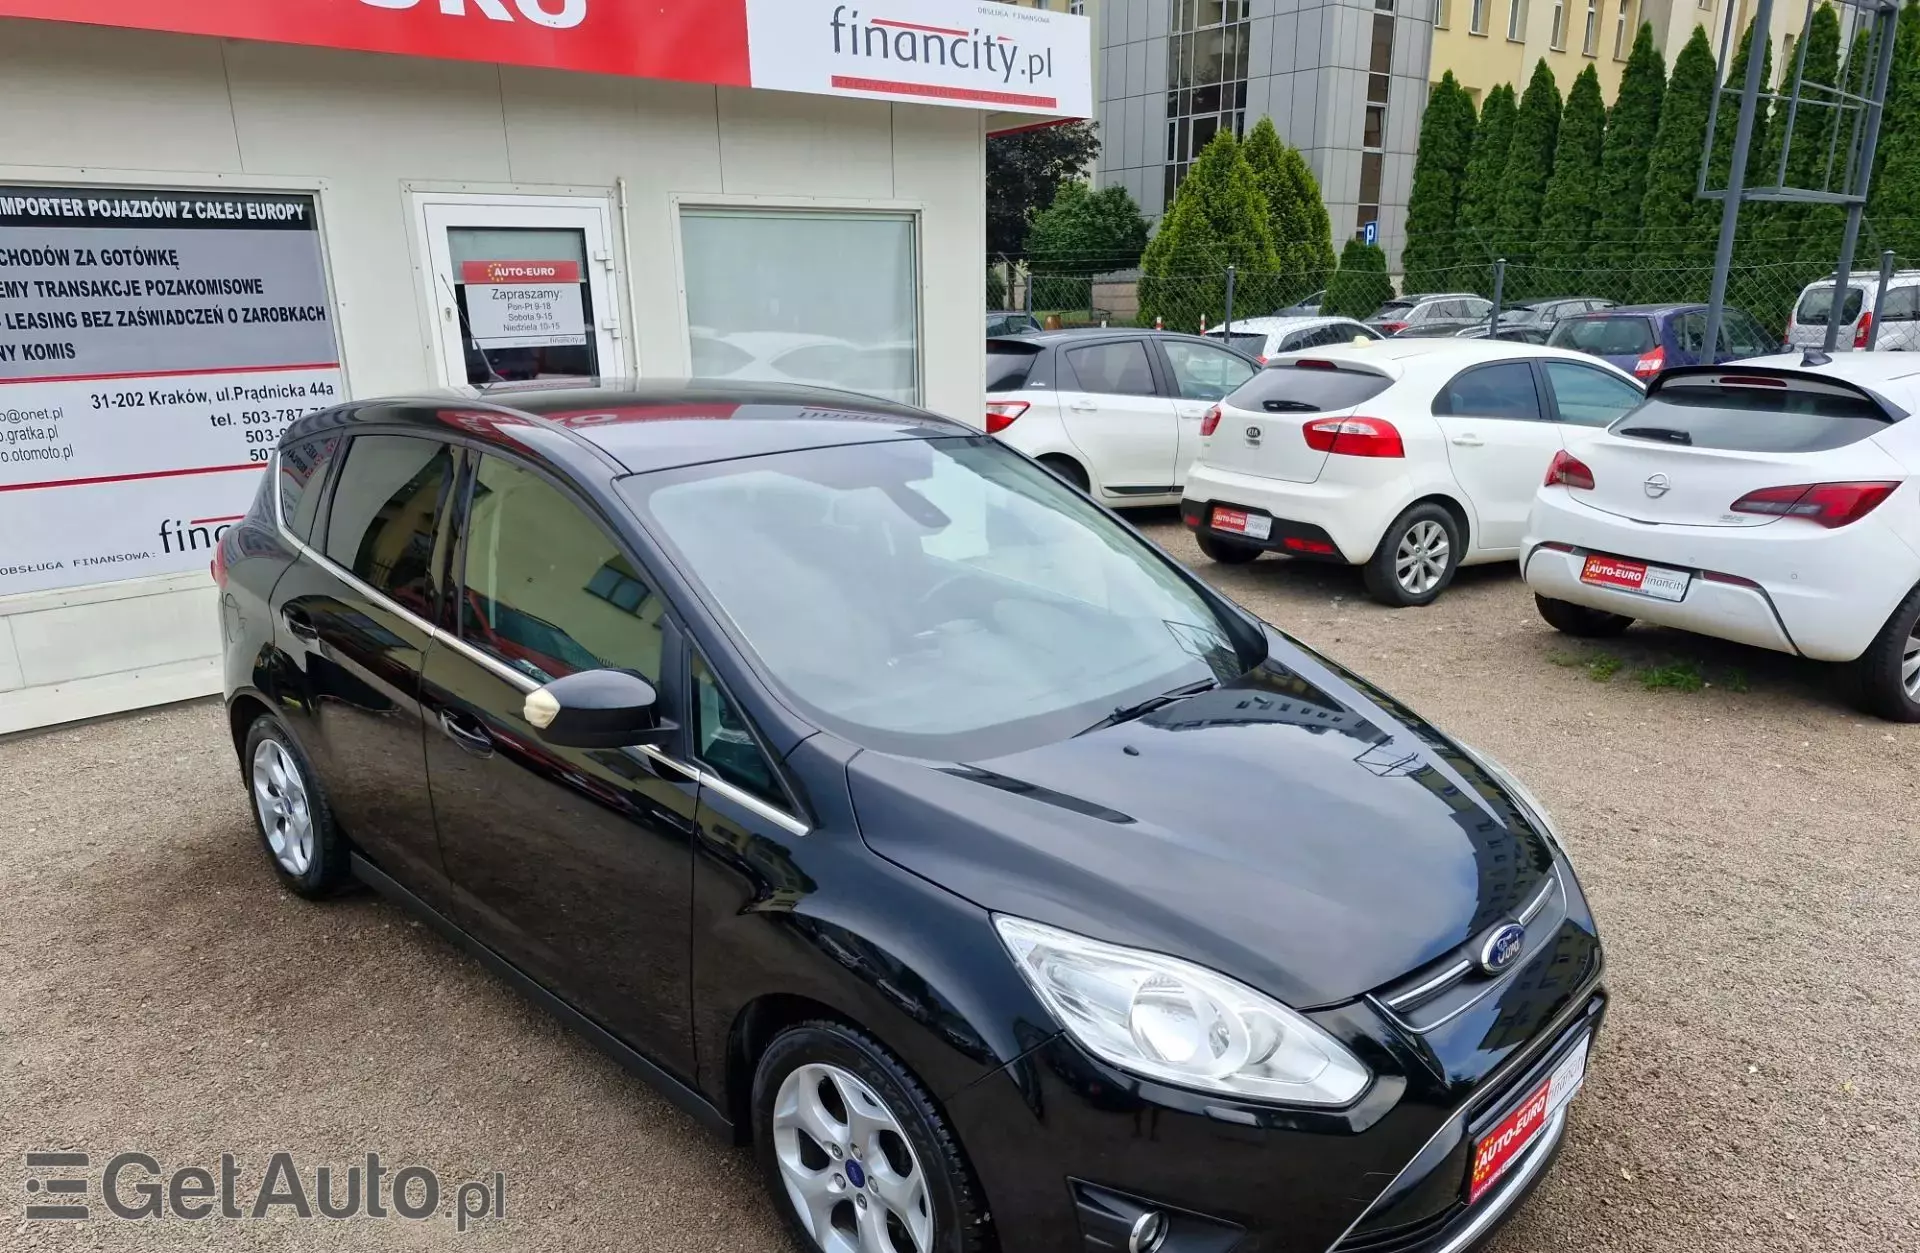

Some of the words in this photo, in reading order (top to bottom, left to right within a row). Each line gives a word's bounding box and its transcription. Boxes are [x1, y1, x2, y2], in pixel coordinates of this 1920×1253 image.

[830, 5, 1053, 84] financity.pl
[0, 197, 85, 217] MPORTER
[88, 197, 177, 219] POJAZDÓW
[180, 202, 193, 219] Z
[195, 201, 243, 220] CAŁEJ
[246, 202, 304, 221] EUROPY
[1366, 225, 1374, 246] P
[73, 249, 97, 267] ZA
[101, 246, 180, 270] GOTÓWKĘ
[494, 267, 556, 277] AUTO-EURO
[34, 279, 142, 298] TRANSAKCJE
[145, 278, 264, 296] POZAKOMISOWE
[534, 302, 552, 310] 9-18
[5, 311, 78, 330] LEASING
[81, 310, 114, 328] BEZ
[116, 304, 225, 328] ZAŚWIADCZEŃ
[228, 308, 238, 324] O
[241, 305, 326, 324] ZAROBKACH
[503, 323, 538, 332] Niedziela
[540, 322, 561, 331] 10-15
[508, 314, 535, 322] Sobota
[536, 312, 553, 321] 9-15
[21, 342, 76, 361] KOMIS
[91, 391, 145, 409] 31-202
[149, 388, 212, 406] Kraków,
[215, 384, 306, 404] ul.Prądnicka
[309, 382, 334, 397] 44a
[210, 413, 237, 427] tel.
[1247, 427, 1260, 437] KIA
[250, 448, 275, 461] 50
[0, 560, 64, 576] OBSŁUGA
[73, 551, 156, 568] FINANSOWA:
[1589, 564, 1642, 582] AUTO-EURO
[1497, 932, 1520, 964] Ford
[1479, 1096, 1546, 1170] AUTO-EURO
